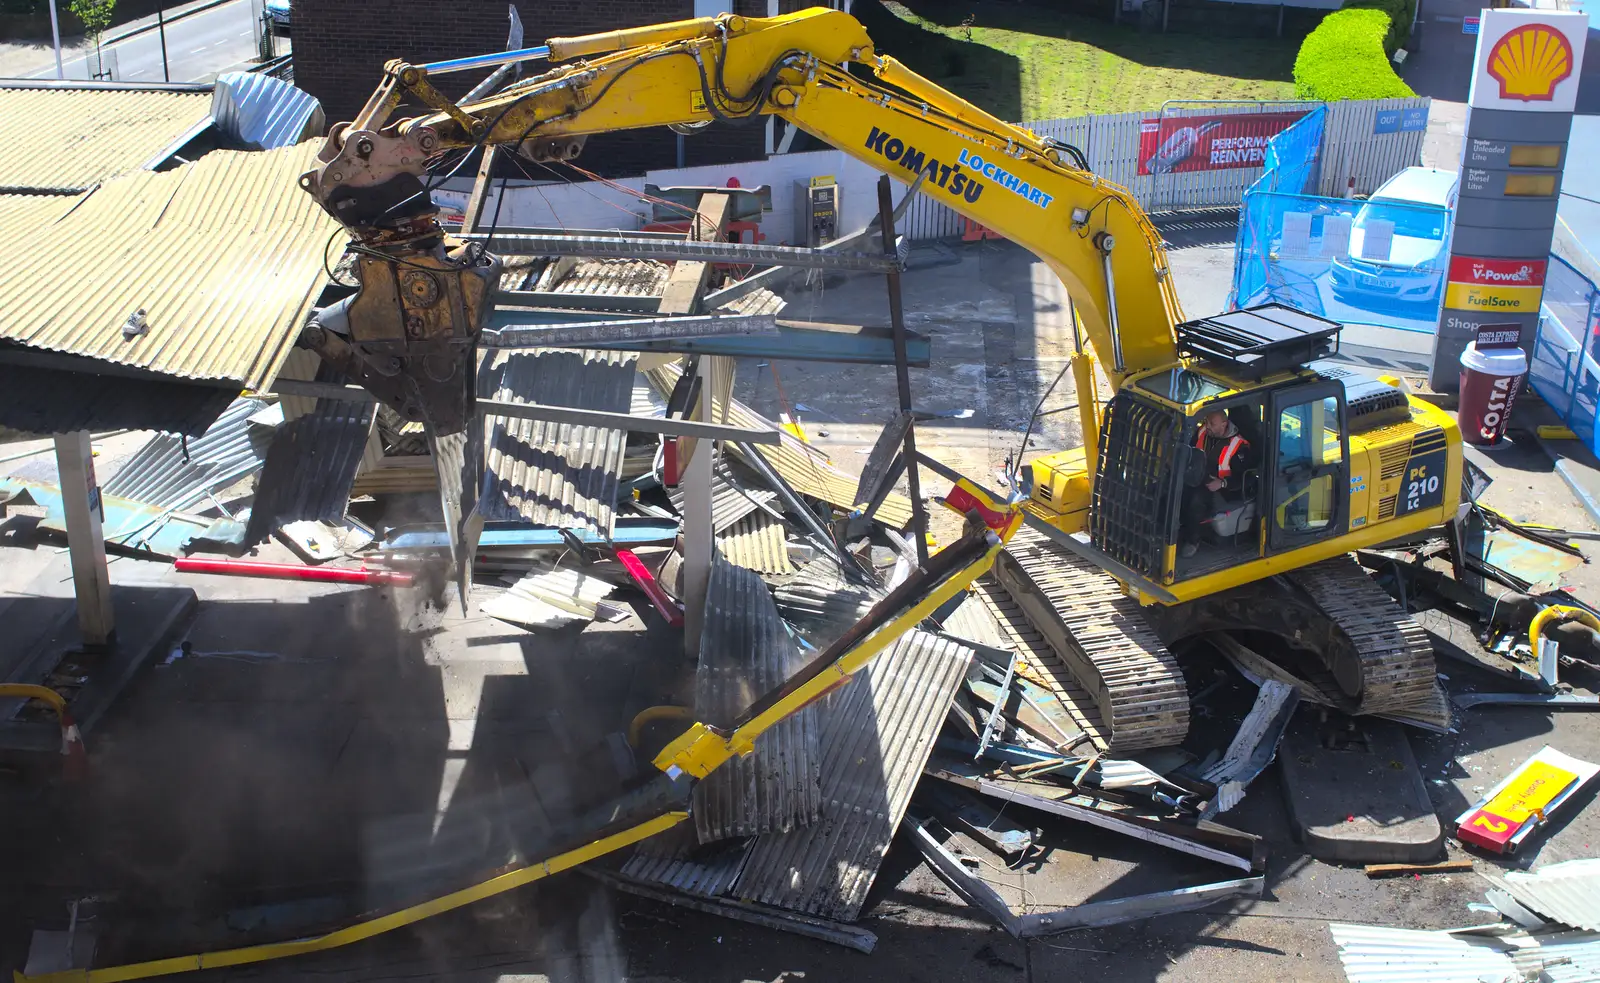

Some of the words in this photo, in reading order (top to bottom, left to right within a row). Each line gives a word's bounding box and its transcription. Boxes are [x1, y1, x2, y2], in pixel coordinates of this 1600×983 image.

[1380, 116, 1396, 125] OUT
[1403, 119, 1425, 127] ENTRY
[1473, 145, 1506, 154] Unleaded
[1472, 153, 1487, 161] Litre
[864, 126, 984, 203] KOMATSU
[957, 148, 1054, 209] LOCKHART
[1468, 174, 1490, 182] Diesel
[1467, 182, 1483, 190] Litre
[1468, 295, 1521, 307] FuelSave
[1447, 317, 1480, 334] Shop
[1478, 331, 1494, 339] COSTA
[1495, 330, 1520, 338] EXPRESS
[1503, 375, 1521, 421] EXPRESS
[1480, 377, 1511, 440] COSTA
[1410, 465, 1427, 480] PC
[1407, 475, 1439, 499] 210
[1407, 498, 1420, 511] LC
[1473, 815, 1509, 833] 2
